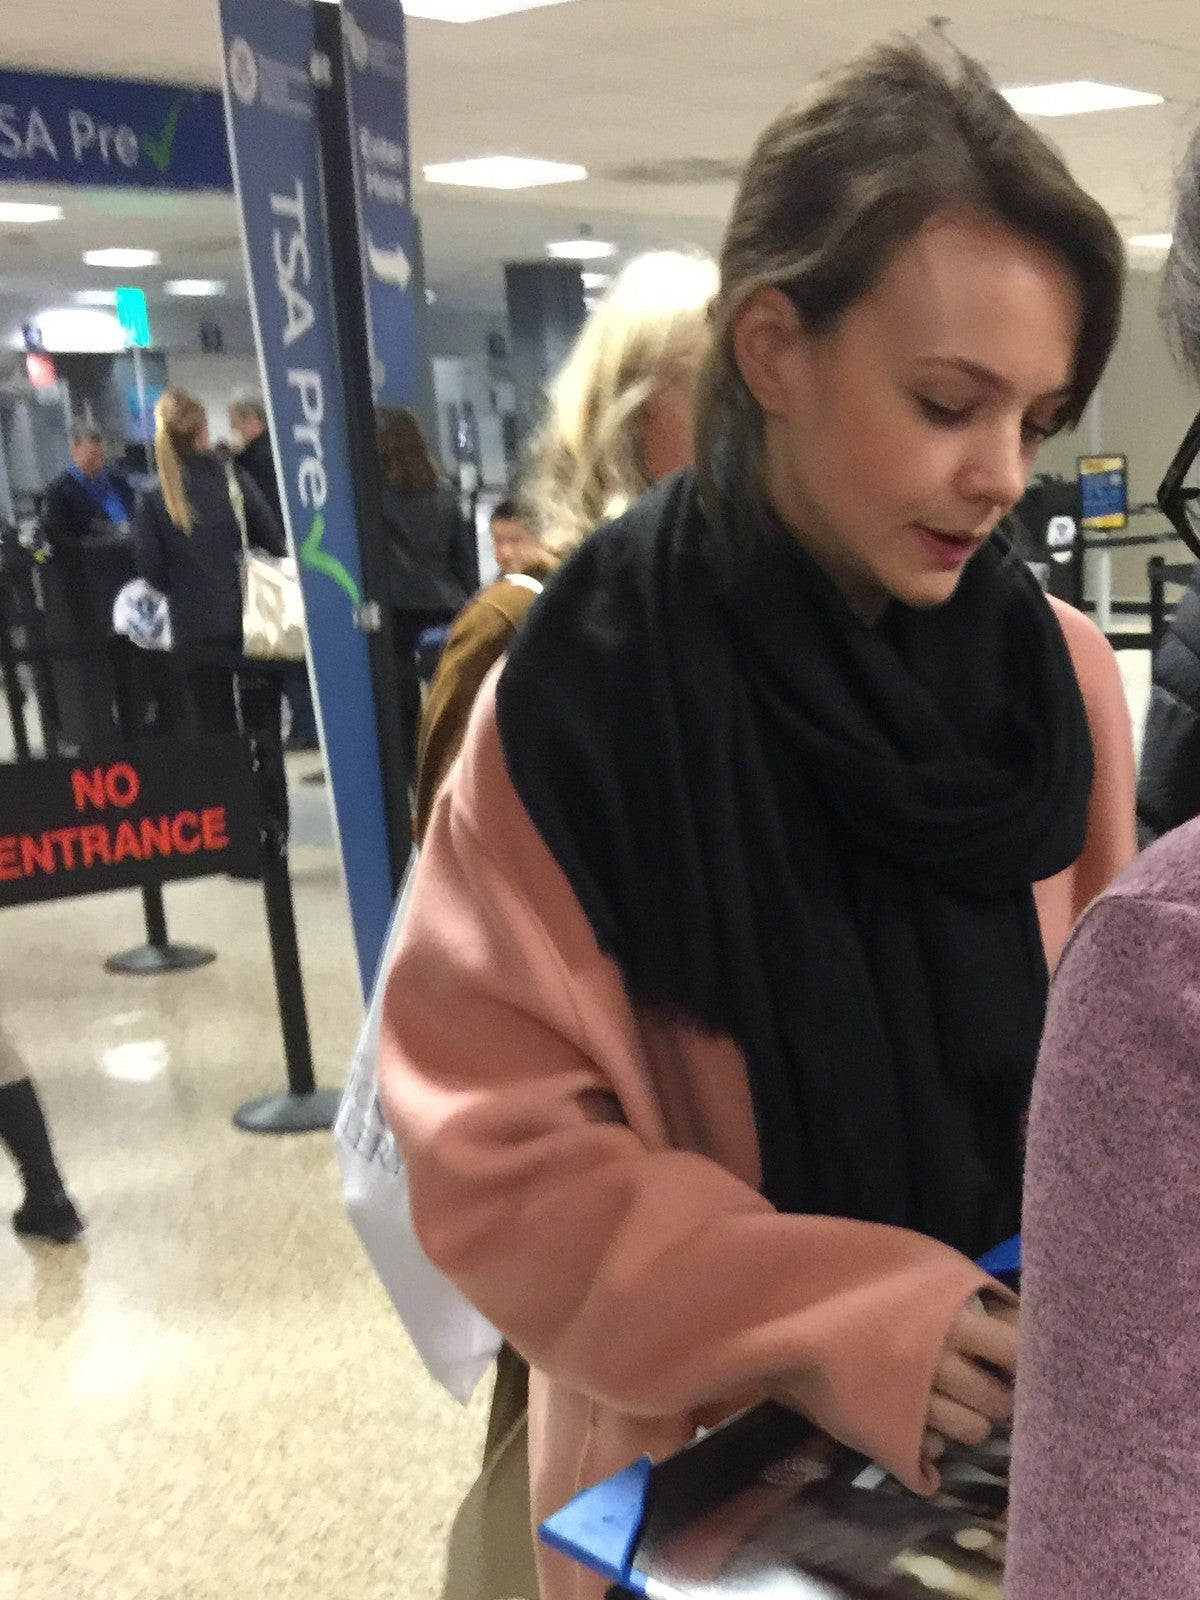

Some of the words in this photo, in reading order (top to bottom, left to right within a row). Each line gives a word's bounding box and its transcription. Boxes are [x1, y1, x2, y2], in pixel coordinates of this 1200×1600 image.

[0, 104, 59, 161] SA
[68, 108, 139, 168] Pre
[269, 175, 315, 347] TSA
[287, 367, 328, 511] Pre
[70, 761, 140, 812] NO
[0, 806, 229, 880] ENTRANCE
